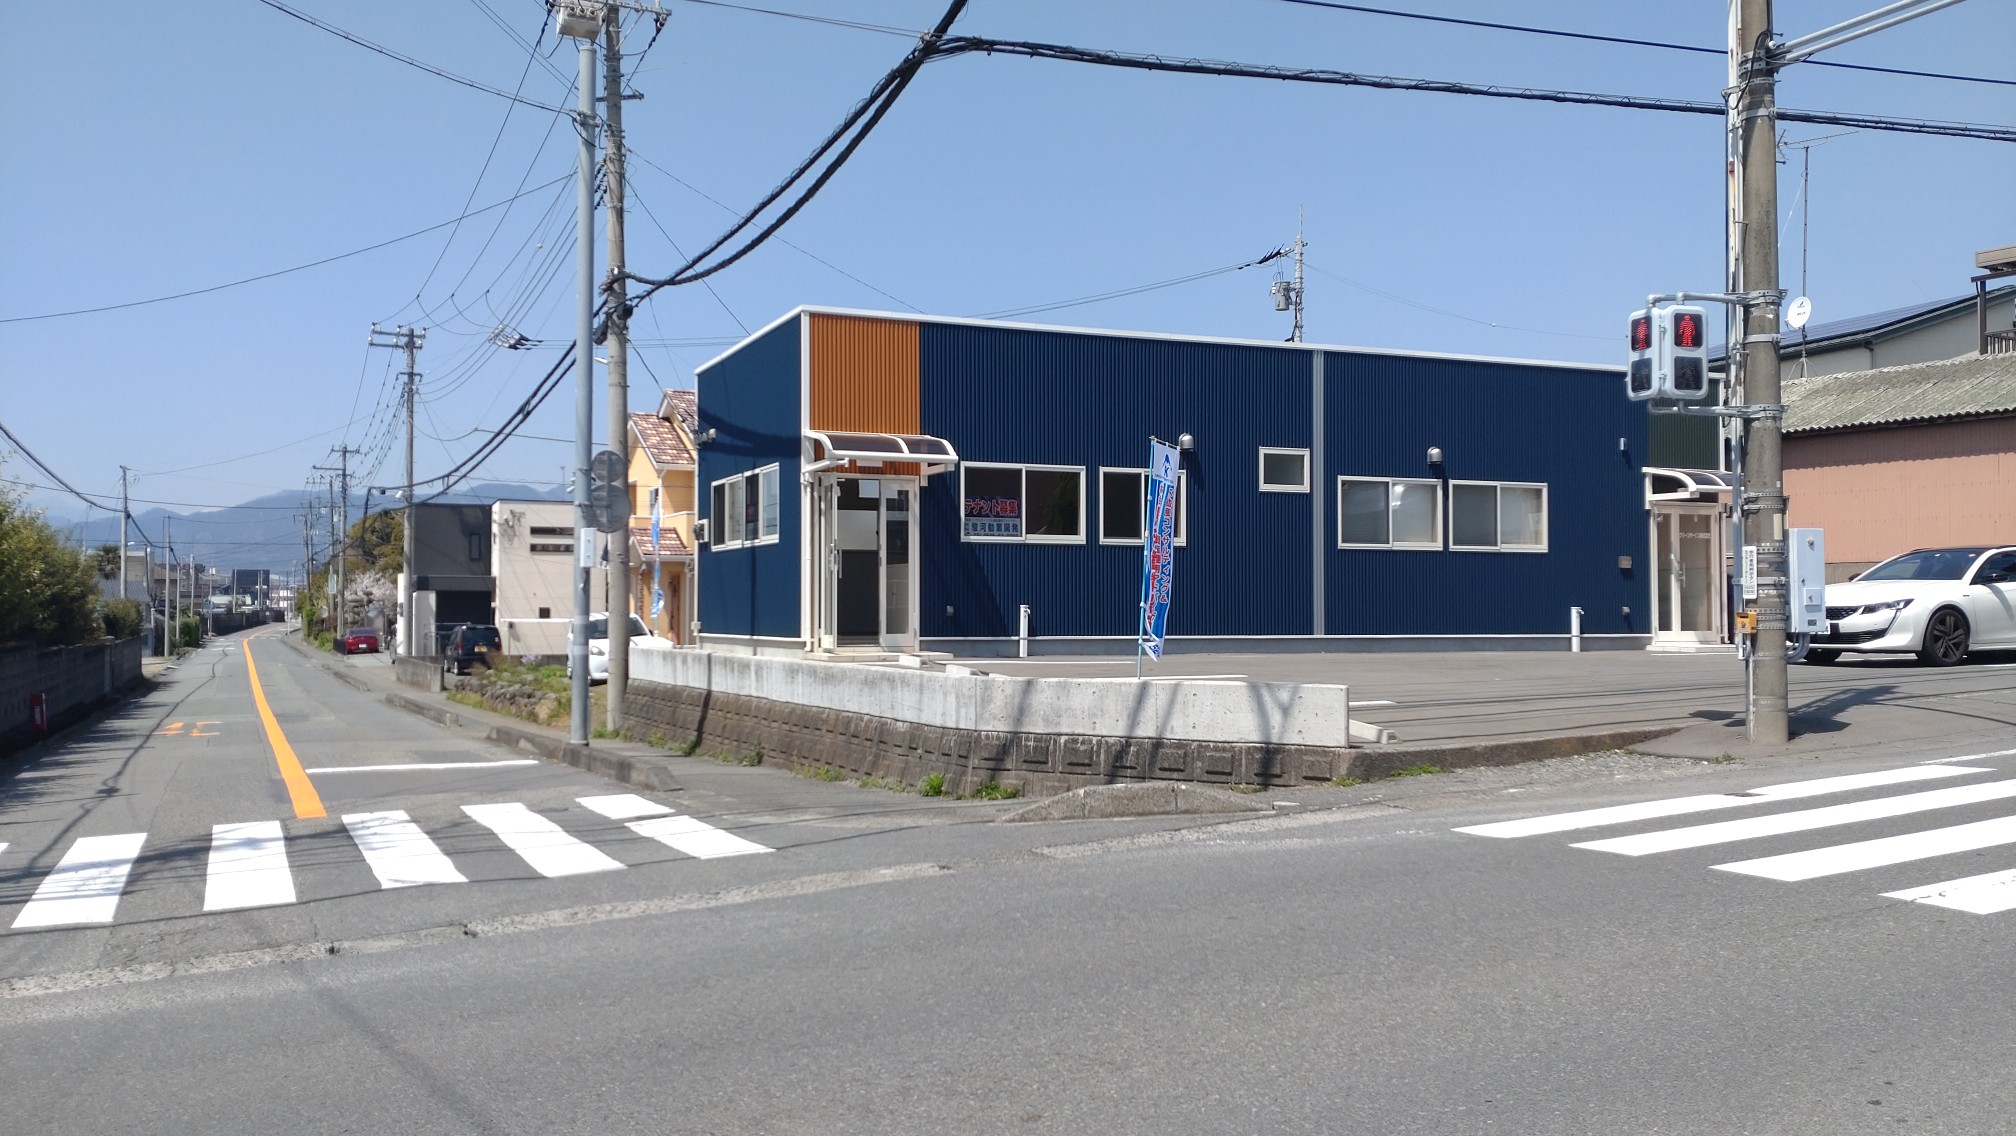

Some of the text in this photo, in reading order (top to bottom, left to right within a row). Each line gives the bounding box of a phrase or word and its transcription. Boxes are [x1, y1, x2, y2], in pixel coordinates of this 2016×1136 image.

[964, 498, 1018, 516] テナント募集
